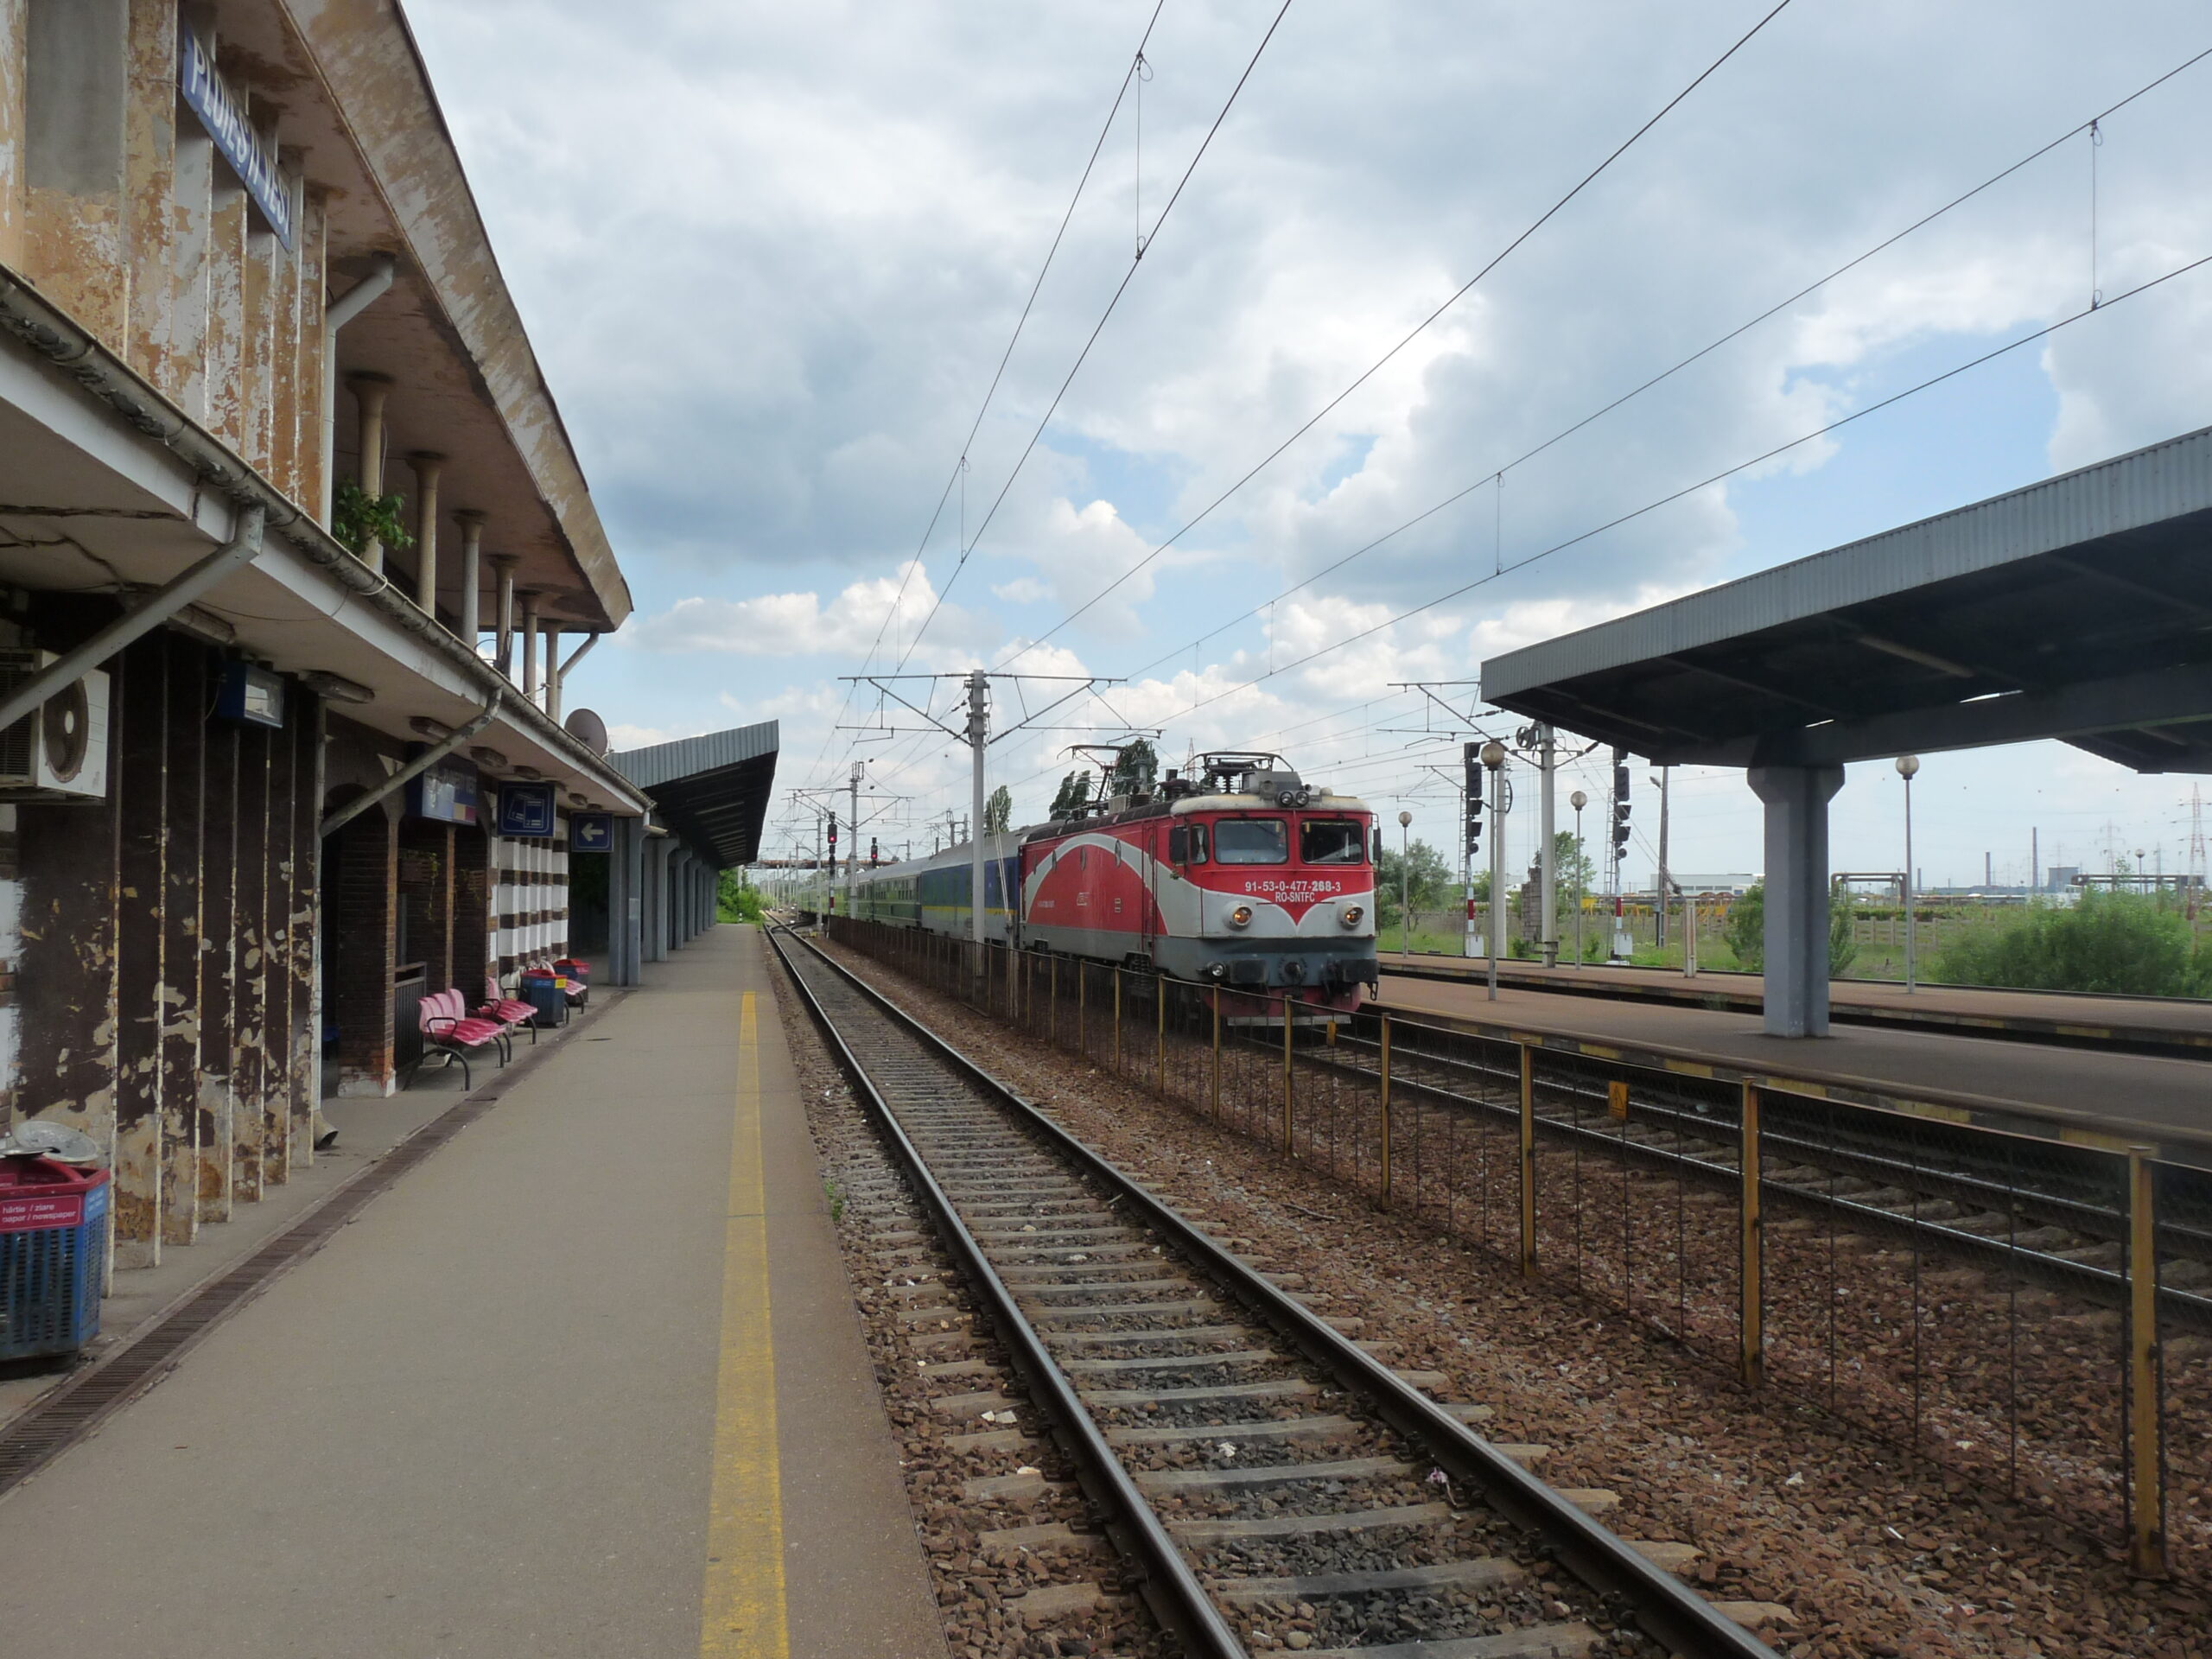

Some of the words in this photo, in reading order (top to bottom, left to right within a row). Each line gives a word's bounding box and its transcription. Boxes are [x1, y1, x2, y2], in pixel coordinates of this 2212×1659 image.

[264, 150, 290, 234] VEST
[1245, 881, 1341, 892] 91-53-0-477-268-3
[1275, 892, 1315, 902] RO-SNTFC
[33, 1211, 76, 1220] newspaper
